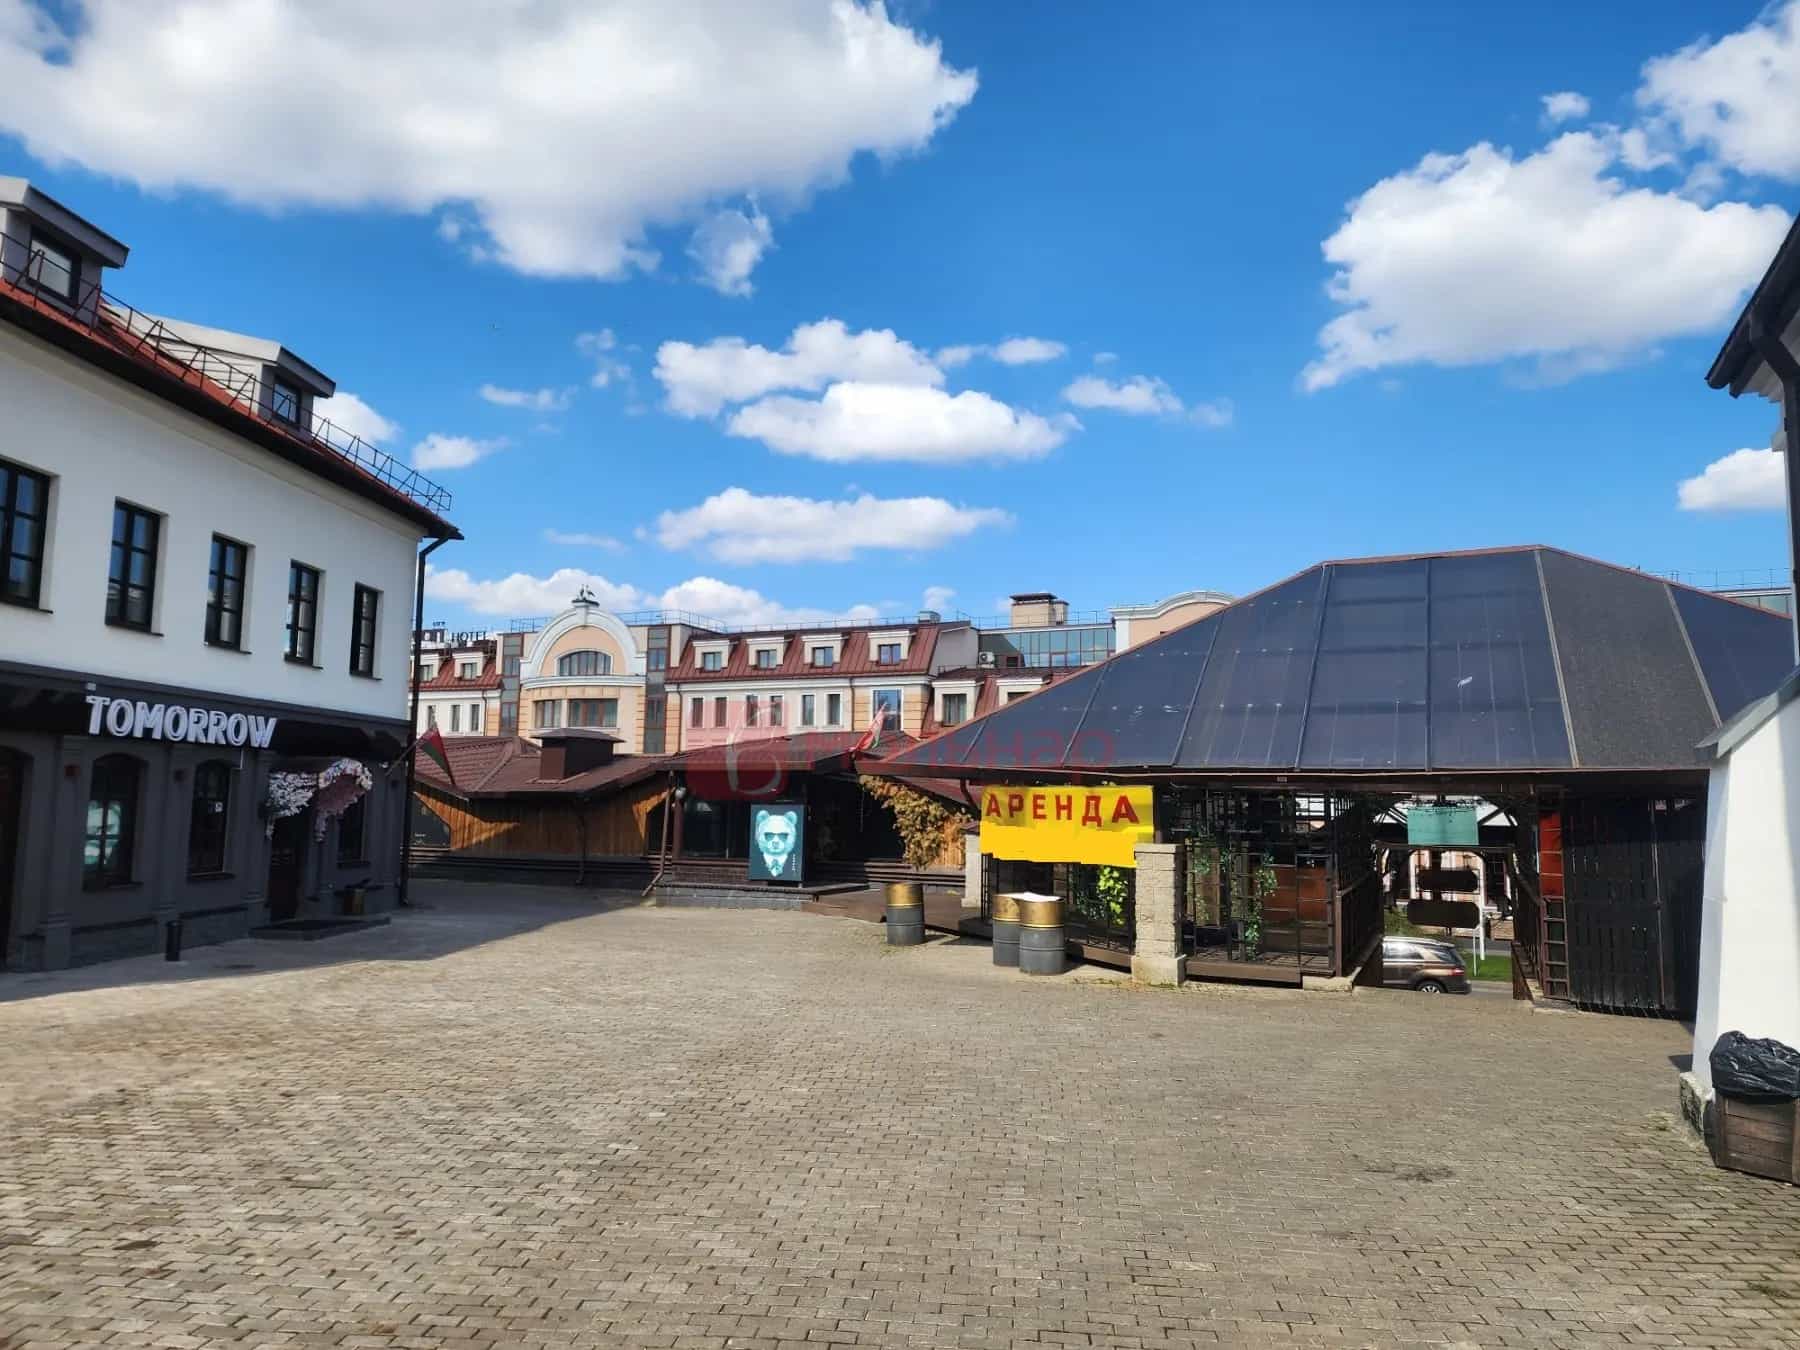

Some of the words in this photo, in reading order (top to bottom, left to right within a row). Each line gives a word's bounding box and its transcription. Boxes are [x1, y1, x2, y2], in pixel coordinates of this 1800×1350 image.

[451, 631, 488, 641] HOTEL
[86, 695, 278, 748] TOMORROW
[985, 792, 1140, 828] АРЕНДА
